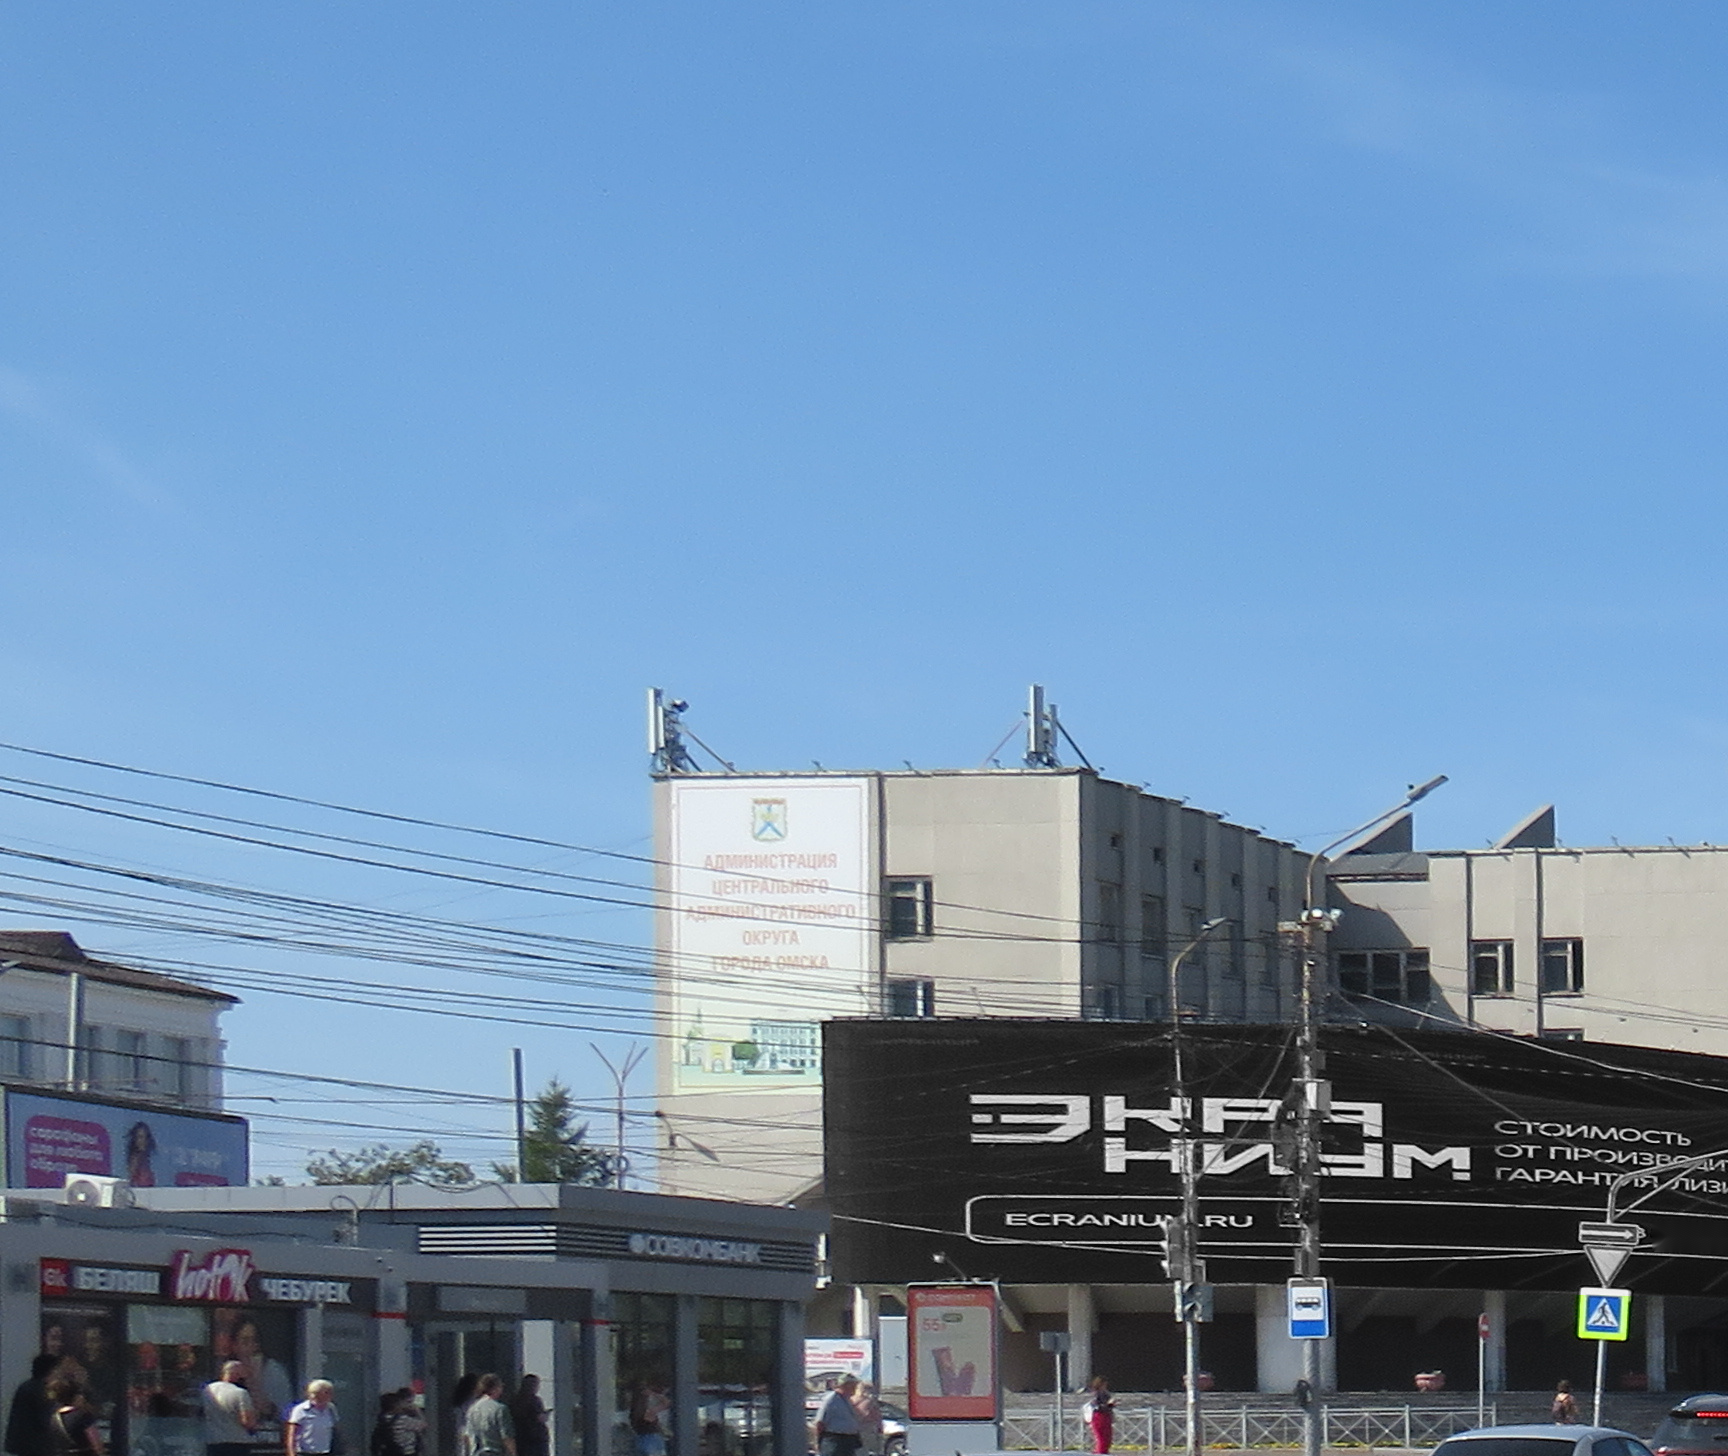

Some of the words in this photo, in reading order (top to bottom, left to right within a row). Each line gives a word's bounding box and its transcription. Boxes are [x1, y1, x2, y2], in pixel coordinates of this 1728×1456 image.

[705, 853, 837, 870] АДМИНИСТРАЦИЯ
[712, 878, 829, 896] ЦЕНТРАЛЬНОГО
[686, 905, 855, 921] АДМИНИСТРАТИВНОГО
[742, 929, 800, 946] ОКРУГА
[713, 955, 771, 972] ГОРОДА
[776, 954, 830, 971] ОМСКА
[1494, 1120, 1692, 1147] СТОИМОСТЬ
[1494, 1143, 1542, 1159] ОТ
[1005, 1212, 1254, 1228] ECRANIU.RU
[645, 1236, 762, 1262] СОВКОМБАНК
[75, 1267, 160, 1294] БЕЛЯШ
[262, 1279, 351, 1304] ЧЕБУРЕК
